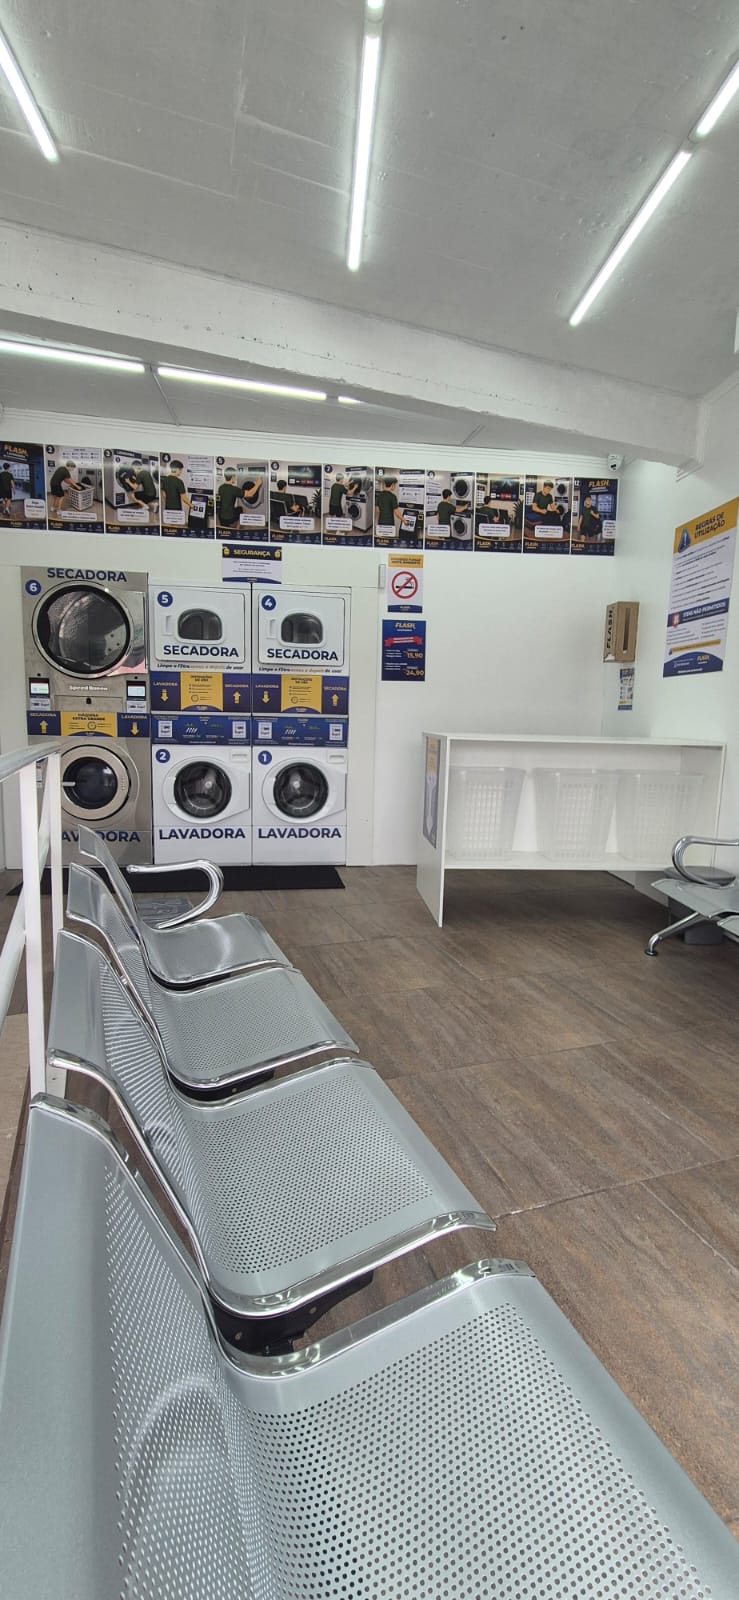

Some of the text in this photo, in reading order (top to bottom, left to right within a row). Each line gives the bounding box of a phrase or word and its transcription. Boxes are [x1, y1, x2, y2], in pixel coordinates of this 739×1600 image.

[696, 516, 716, 530] REGRAS
[695, 519, 725, 539] UTILIZAÇÃO
[47, 568, 127, 582] SECADORA
[30, 583, 37, 592] 6
[161, 595, 168, 603] 5
[264, 598, 273, 607] 4
[163, 645, 239, 657] SECADORA
[267, 648, 338, 661] SECADORA
[160, 752, 167, 760] 2
[263, 753, 267, 762] 1
[62, 831, 140, 842] AVDORA
[159, 828, 246, 840] LAVADORA
[258, 828, 342, 839] LAVADORA
